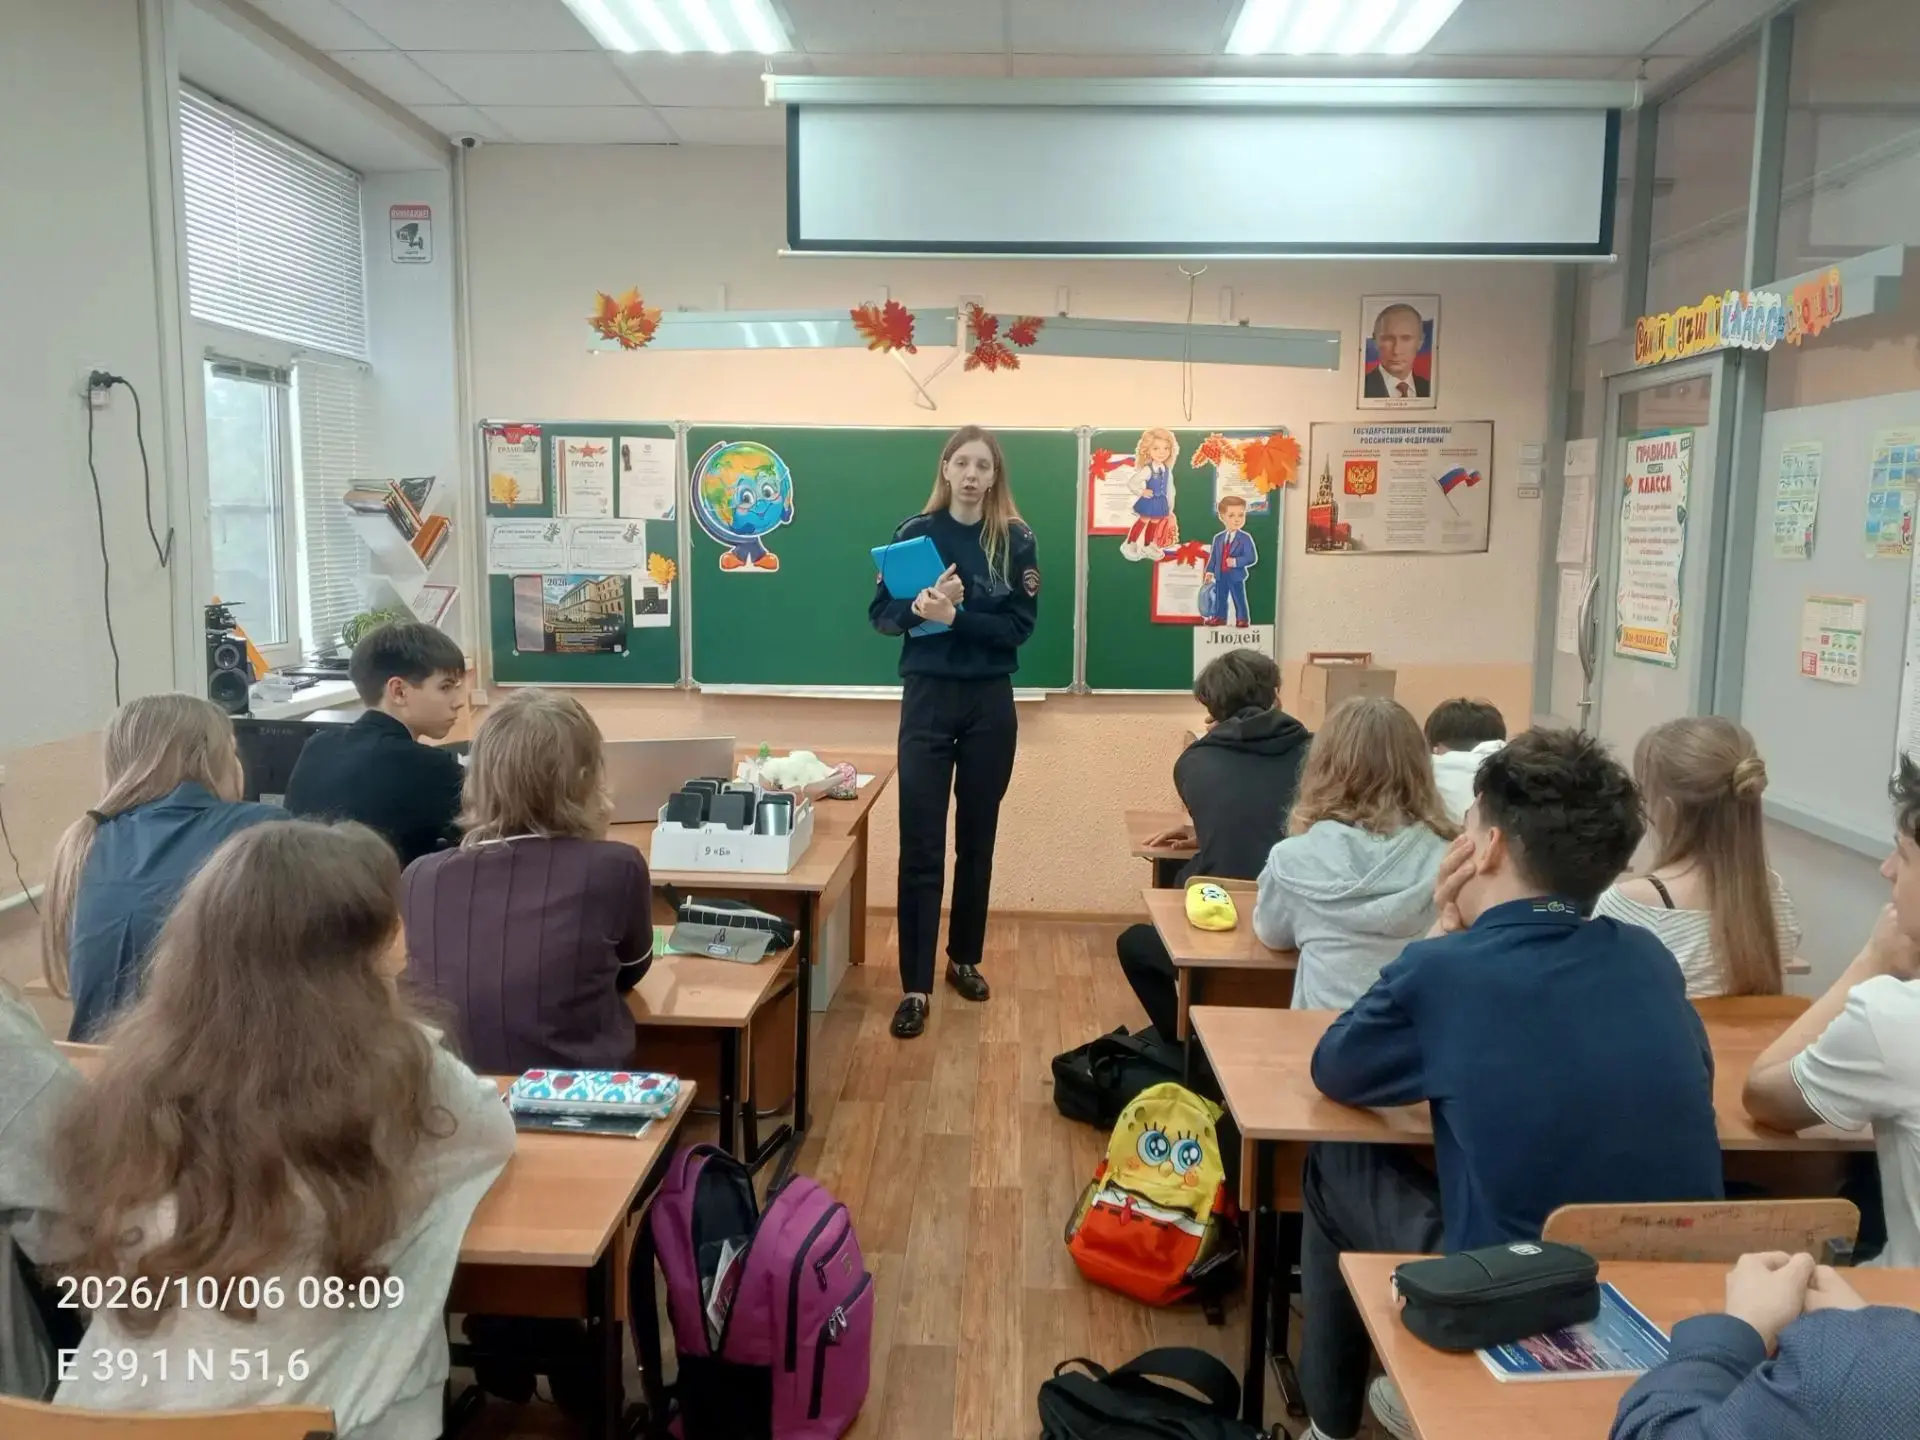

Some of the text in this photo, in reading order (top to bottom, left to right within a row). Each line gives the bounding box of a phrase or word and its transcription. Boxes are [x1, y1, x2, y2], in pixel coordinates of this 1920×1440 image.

[1353, 426, 1452, 435] ГОСУДАРСТВЕННЫЕ СИМВОЛЫ
[1636, 441, 1678, 463] ПРАВИЛА
[1639, 475, 1672, 494] КЛАССА
[1206, 630, 1260, 645] Людей
[704, 846, 711, 856] 9
